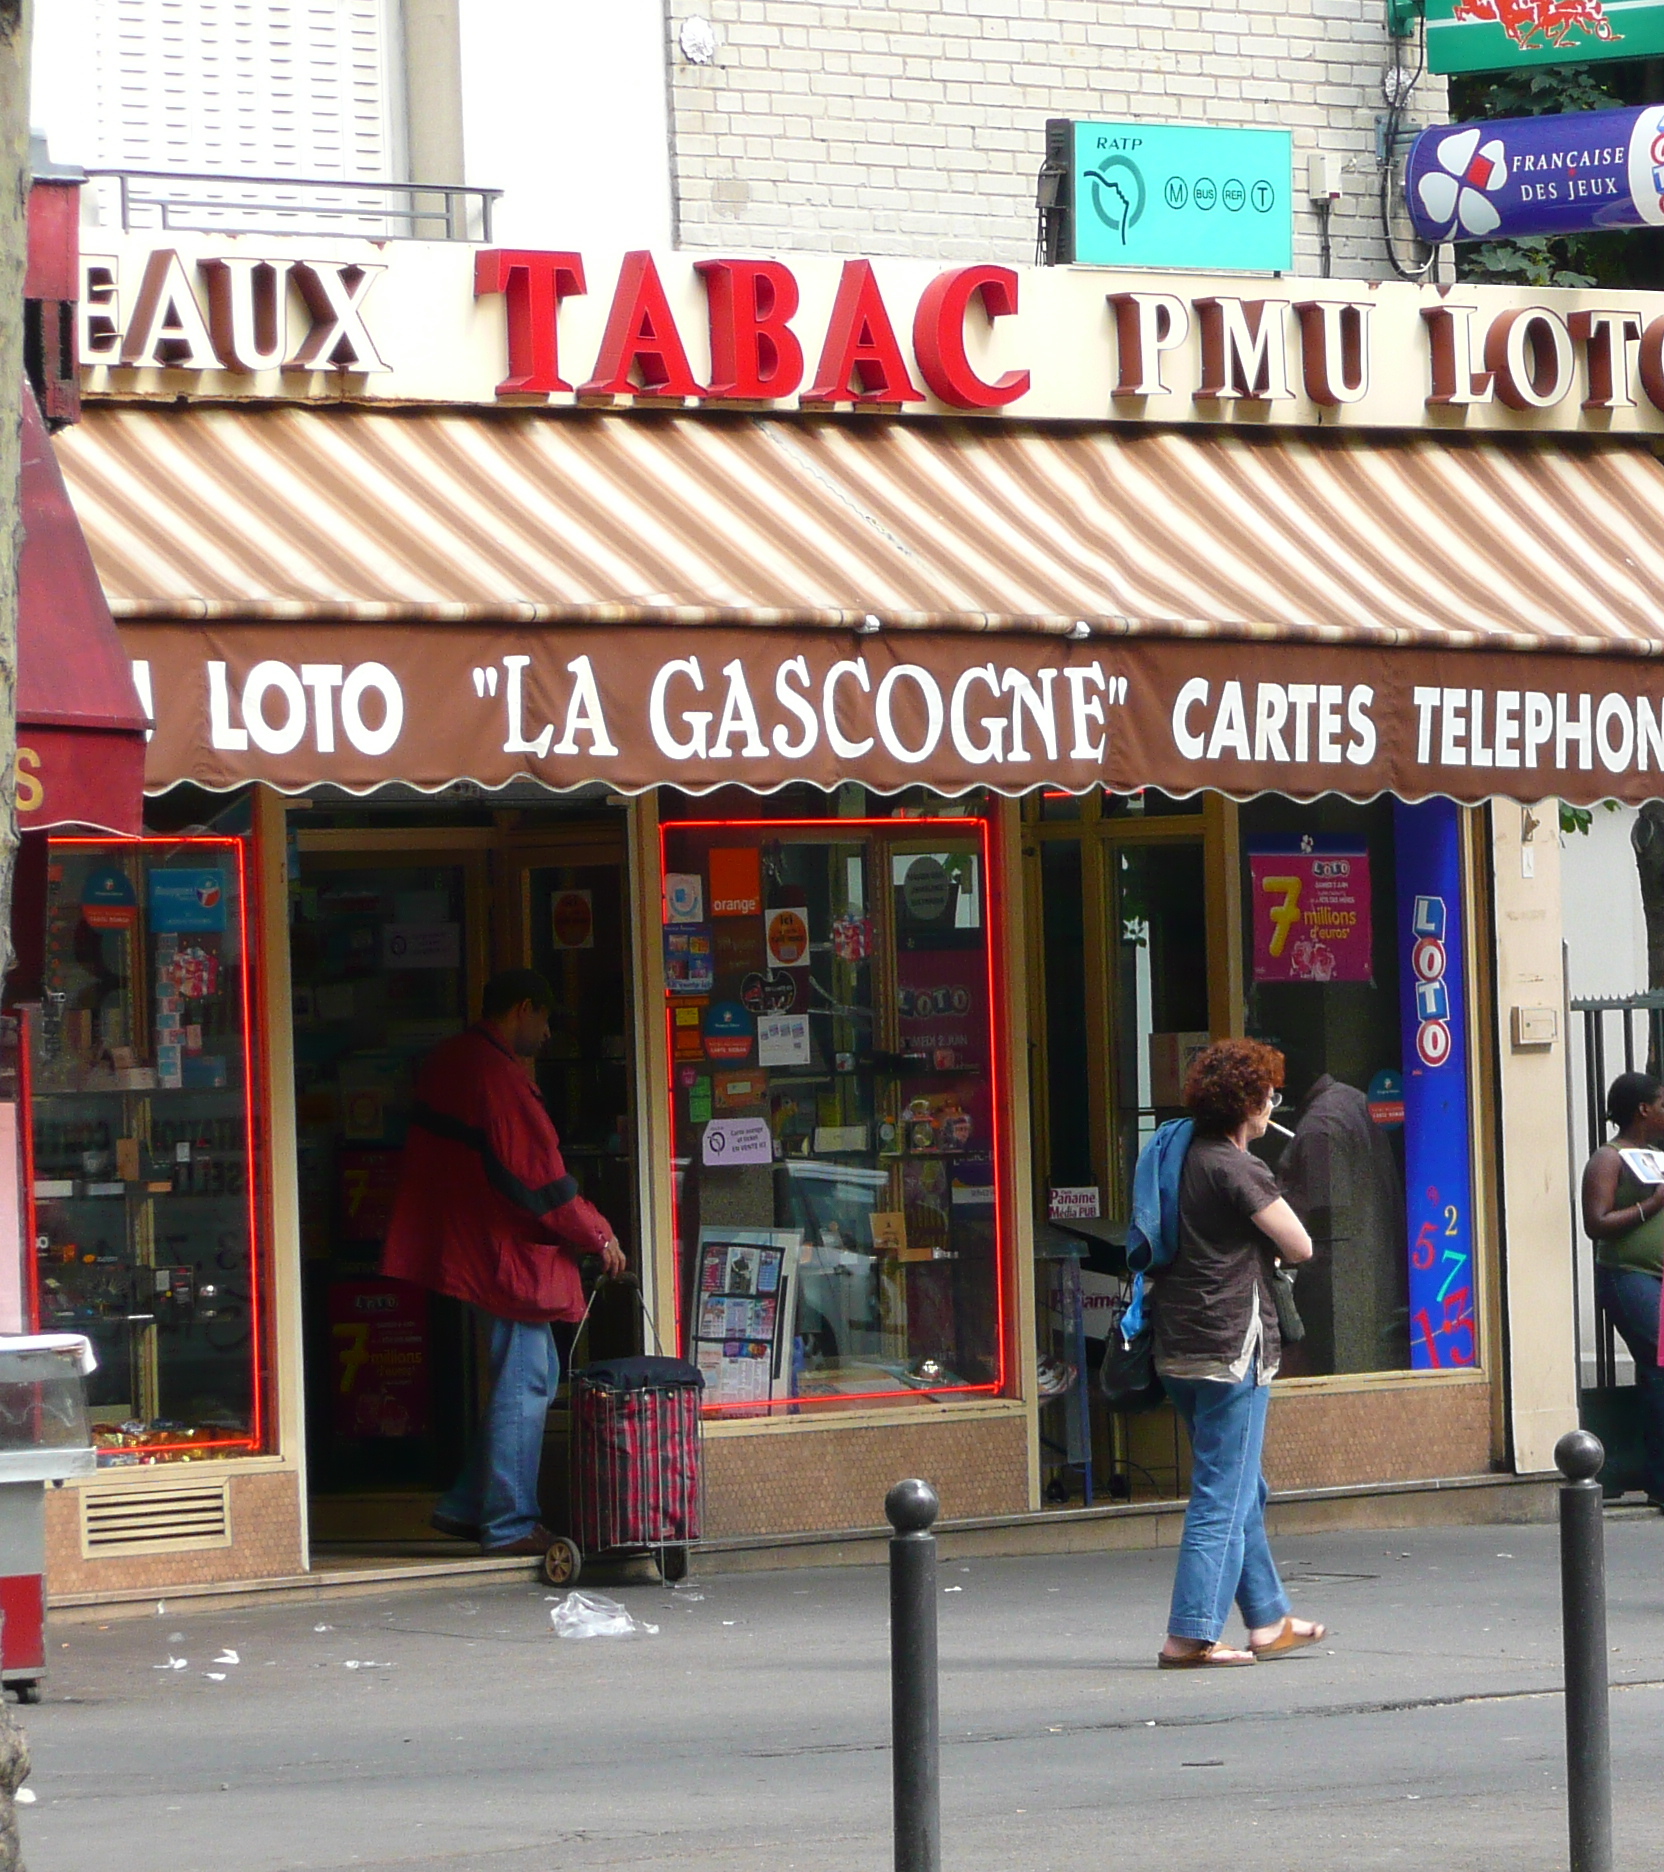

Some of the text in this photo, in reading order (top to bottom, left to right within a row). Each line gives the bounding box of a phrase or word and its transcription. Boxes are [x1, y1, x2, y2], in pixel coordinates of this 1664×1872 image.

[1096, 136, 1144, 151] RATP
[1196, 187, 1215, 201] BUS
[1224, 188, 1244, 202] RER
[1520, 177, 1619, 202] DES JEUX
[474, 248, 1031, 410] TABAC
[1106, 292, 1374, 406] PMU
[207, 660, 404, 756] LOTO
[472, 655, 619, 759] "LA
[649, 654, 1128, 766] GASCOGNE"
[1172, 677, 1377, 765] CARTES
[1312, 860, 1350, 878] LOTO
[713, 898, 757, 915] orange
[1262, 876, 1302, 958] 7
[1304, 906, 1356, 926] millions
[1412, 895, 1451, 1067] LOTO
[1049, 1189, 1096, 1205] Paname
[1079, 1206, 1096, 1218] PUB
[1443, 1204, 1459, 1237] 2
[1413, 1222, 1438, 1270] 5
[1436, 1248, 1468, 1303] 7
[332, 1322, 370, 1394] 7
